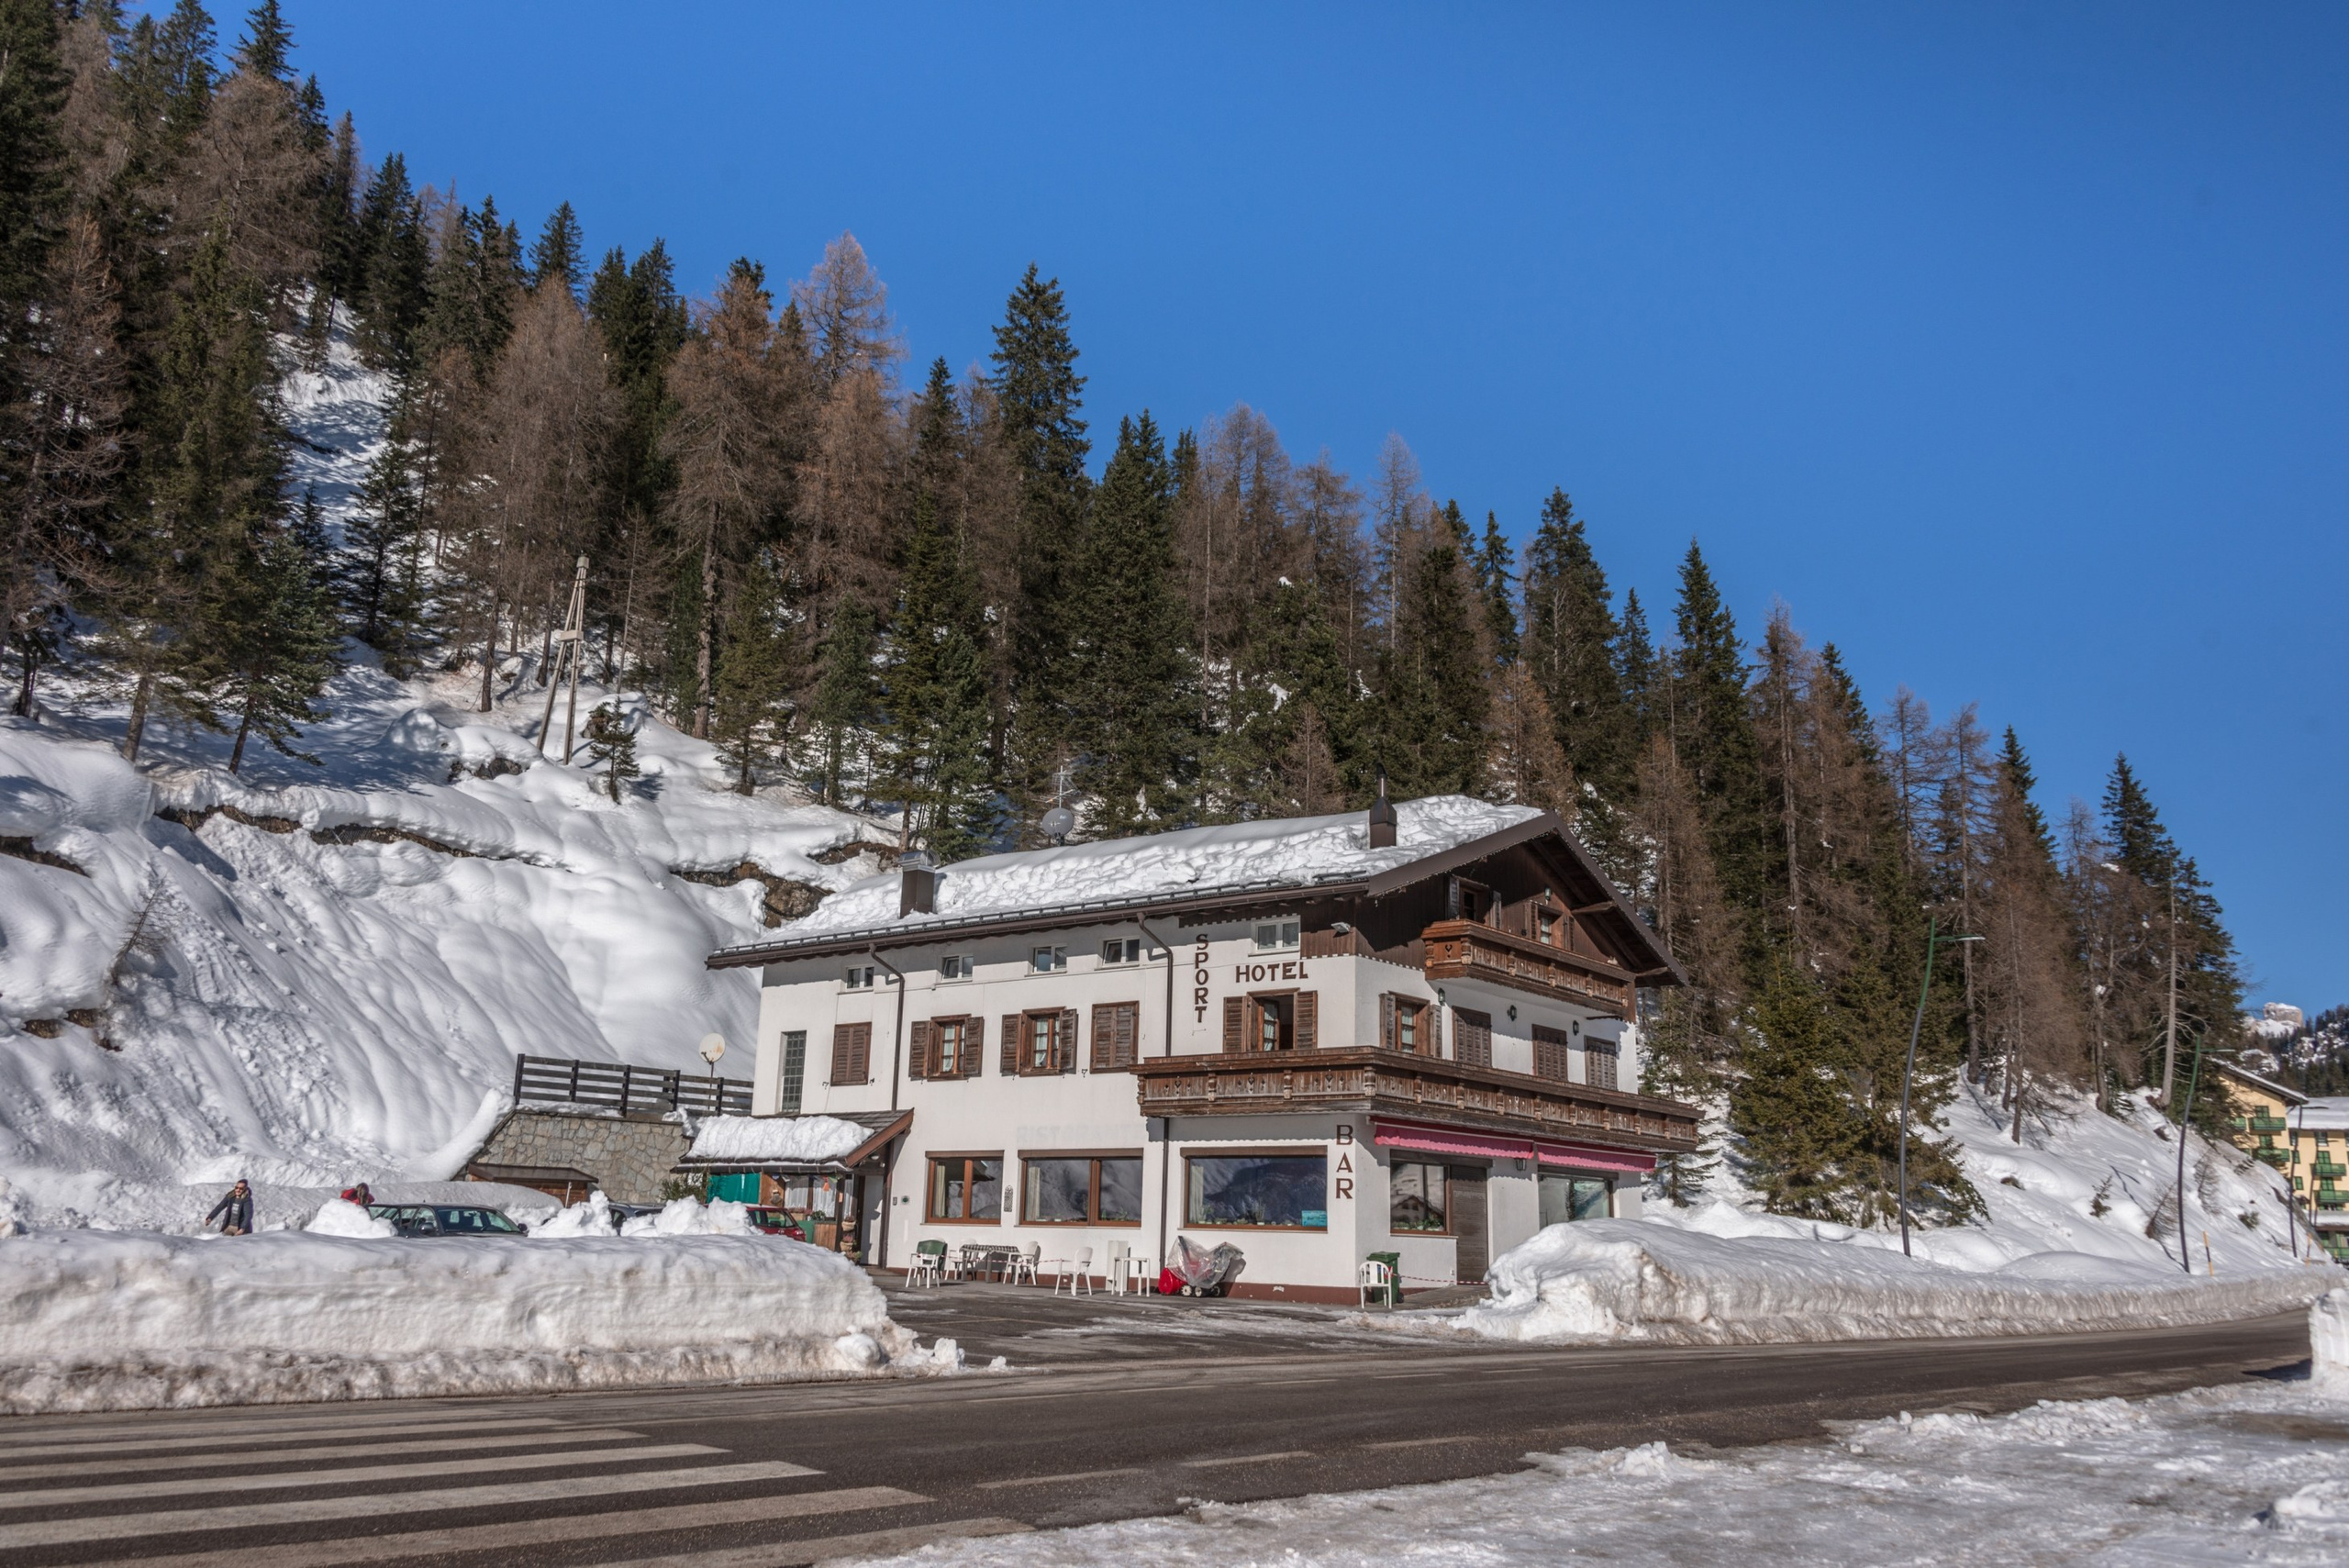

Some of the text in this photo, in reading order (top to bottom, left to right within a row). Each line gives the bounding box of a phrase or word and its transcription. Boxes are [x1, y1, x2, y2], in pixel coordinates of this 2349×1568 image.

[1195, 934, 1209, 1023] SPORT
[1235, 962, 1309, 983] HOTEL
[1336, 1125, 1353, 1199] BAR
